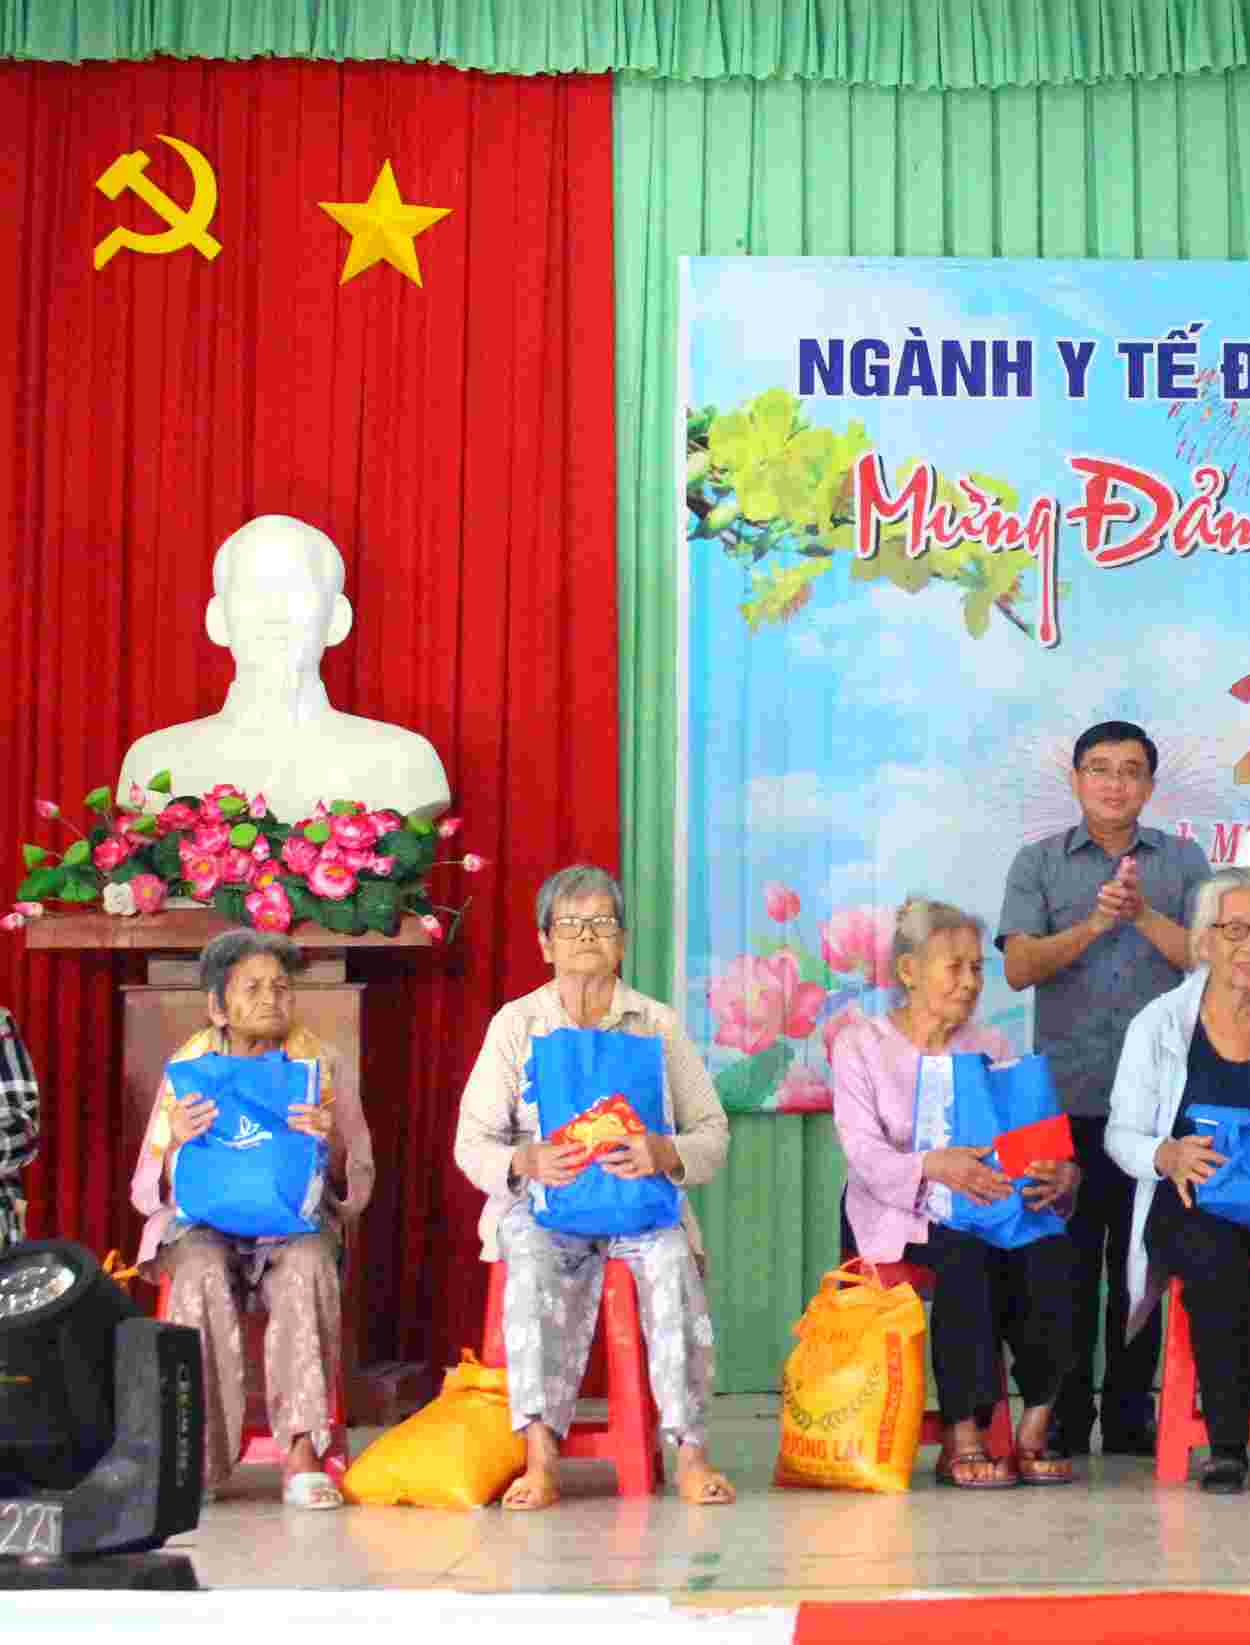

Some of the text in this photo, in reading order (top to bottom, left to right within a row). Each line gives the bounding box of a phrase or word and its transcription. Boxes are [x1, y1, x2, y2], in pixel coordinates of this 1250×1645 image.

[798, 326, 1033, 398] NGÀNH
[1056, 340, 1096, 398] Y
[1117, 323, 1204, 399] TẾ
[856, 452, 1056, 646] Mừng
